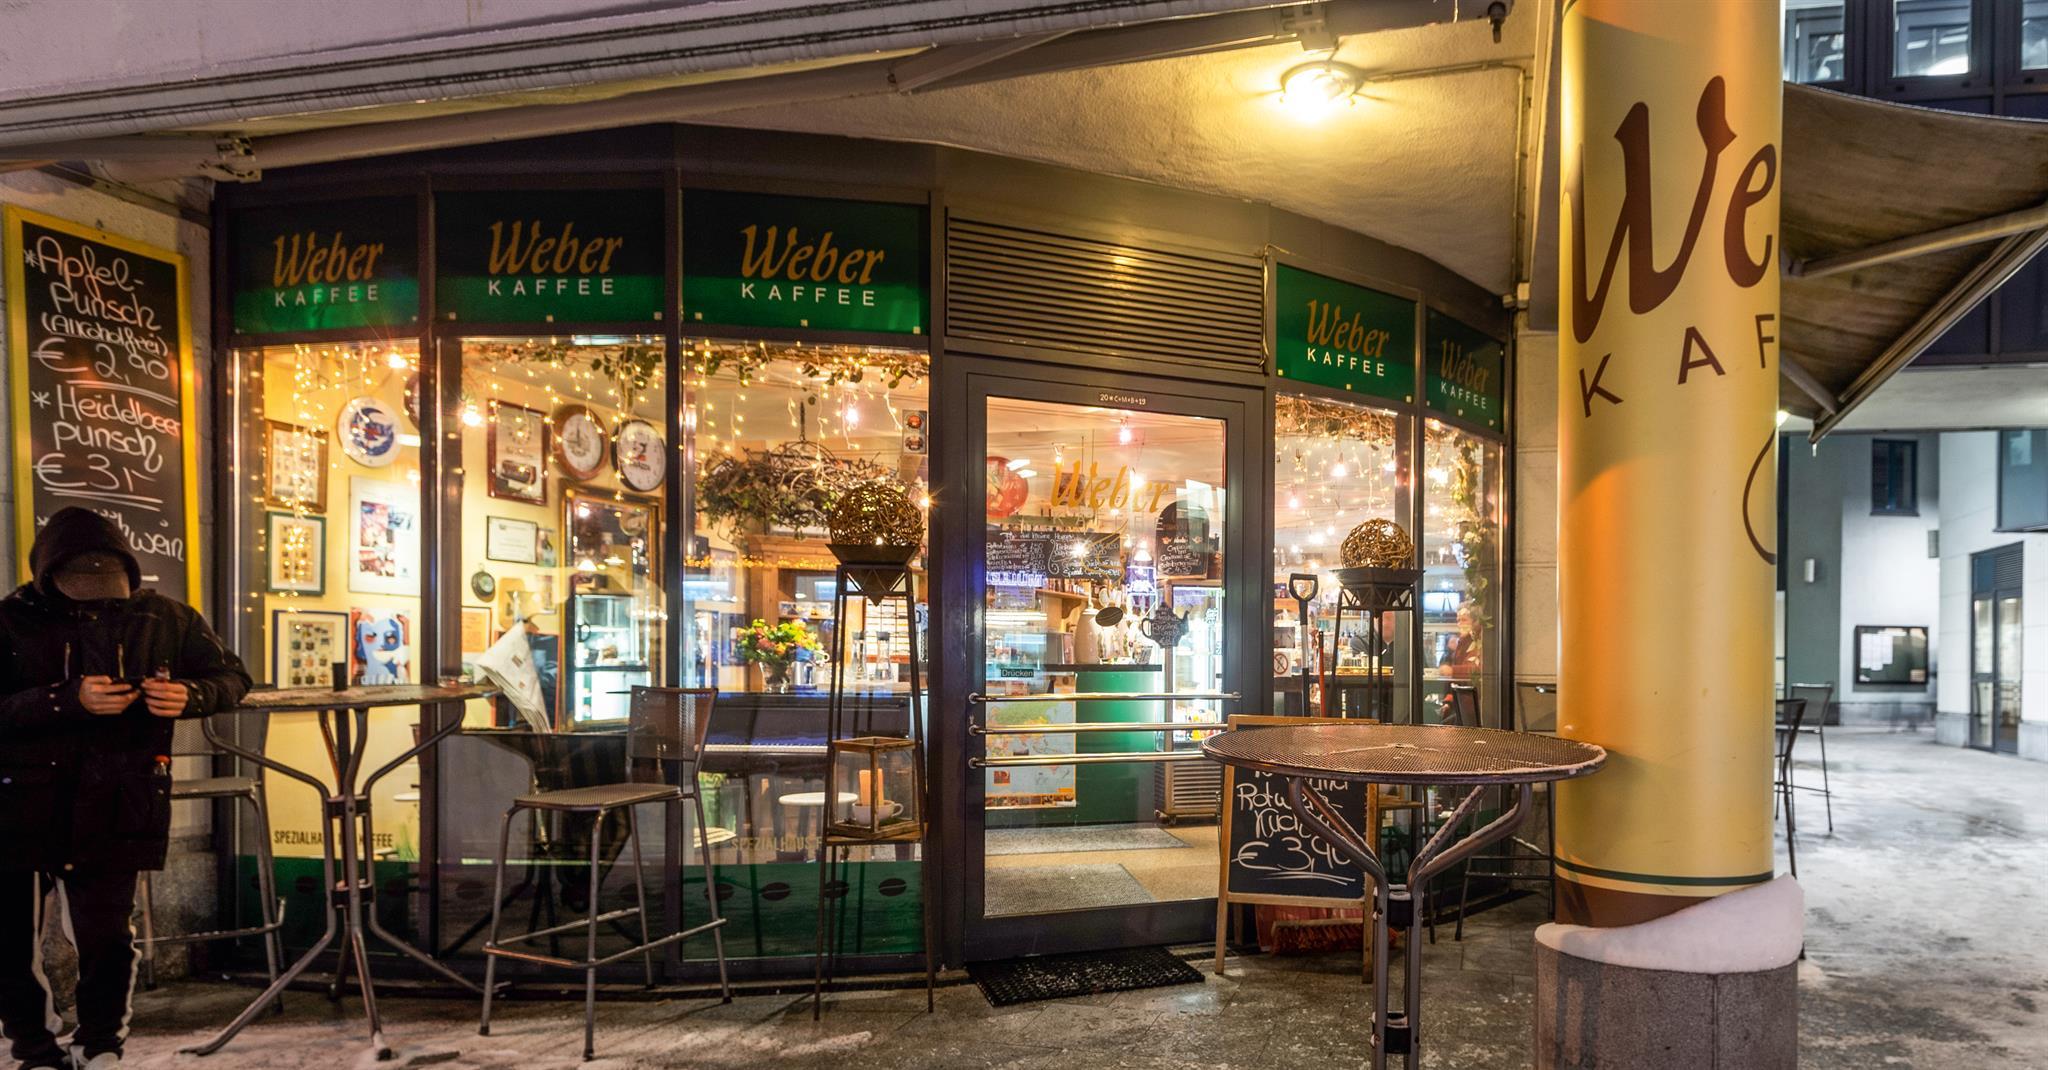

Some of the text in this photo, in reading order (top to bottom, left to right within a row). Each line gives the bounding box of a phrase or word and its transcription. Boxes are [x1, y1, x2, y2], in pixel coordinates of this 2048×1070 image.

[273, 231, 384, 287] Weber
[488, 219, 623, 276] Weber
[741, 224, 884, 285] Weber
[274, 284, 379, 307] KAFFEE
[488, 278, 615, 297] KAFFEE
[741, 283, 876, 307] KAFFEE
[1307, 299, 1390, 358] Weber
[32, 337, 170, 385] € 2,90
[1307, 347, 1385, 377] KAFFEE
[1440, 338, 1489, 393] Weber
[1440, 380, 1487, 410] KAFFEE
[32, 453, 88, 487] €
[1051, 460, 1170, 514] Weber
[1002, 669, 1034, 678] Drücken
[1231, 841, 1283, 871] €
